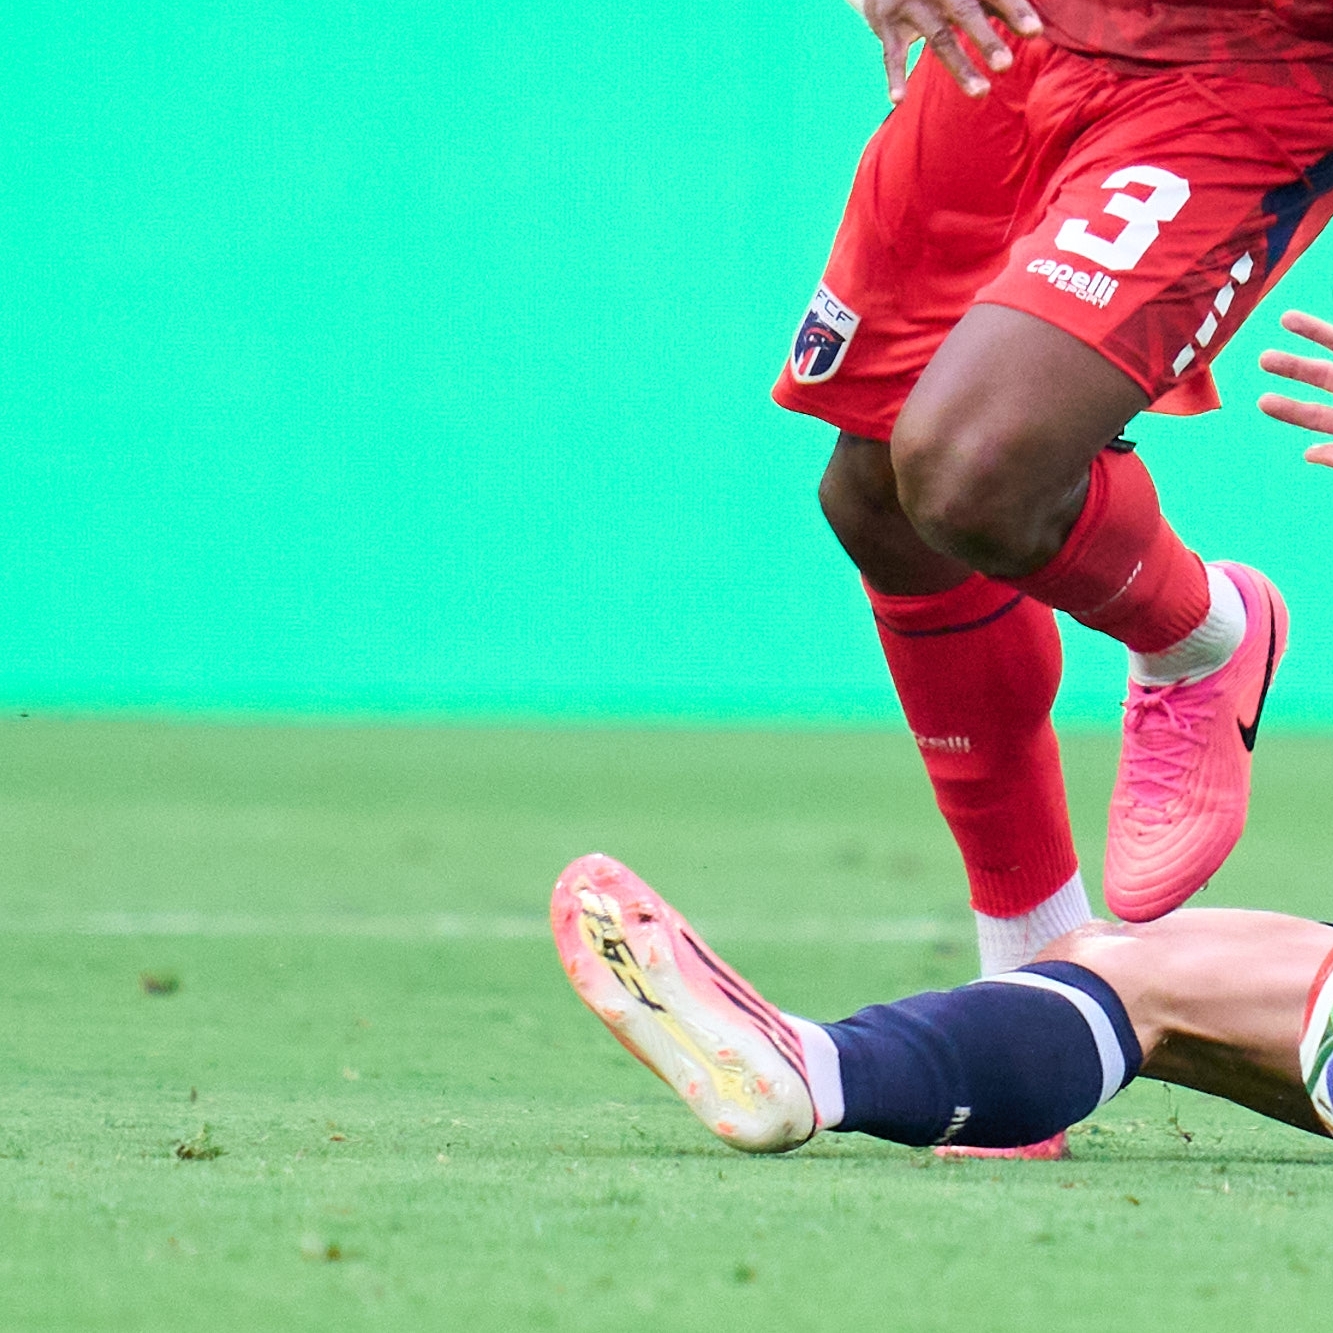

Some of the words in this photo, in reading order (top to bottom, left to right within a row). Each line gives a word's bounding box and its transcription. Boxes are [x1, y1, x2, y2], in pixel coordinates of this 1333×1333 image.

[1053, 164, 1191, 272] 3
[1026, 258, 1120, 305] capelli
[1054, 280, 1108, 310] SPORT
[815, 288, 855, 322] FCF
